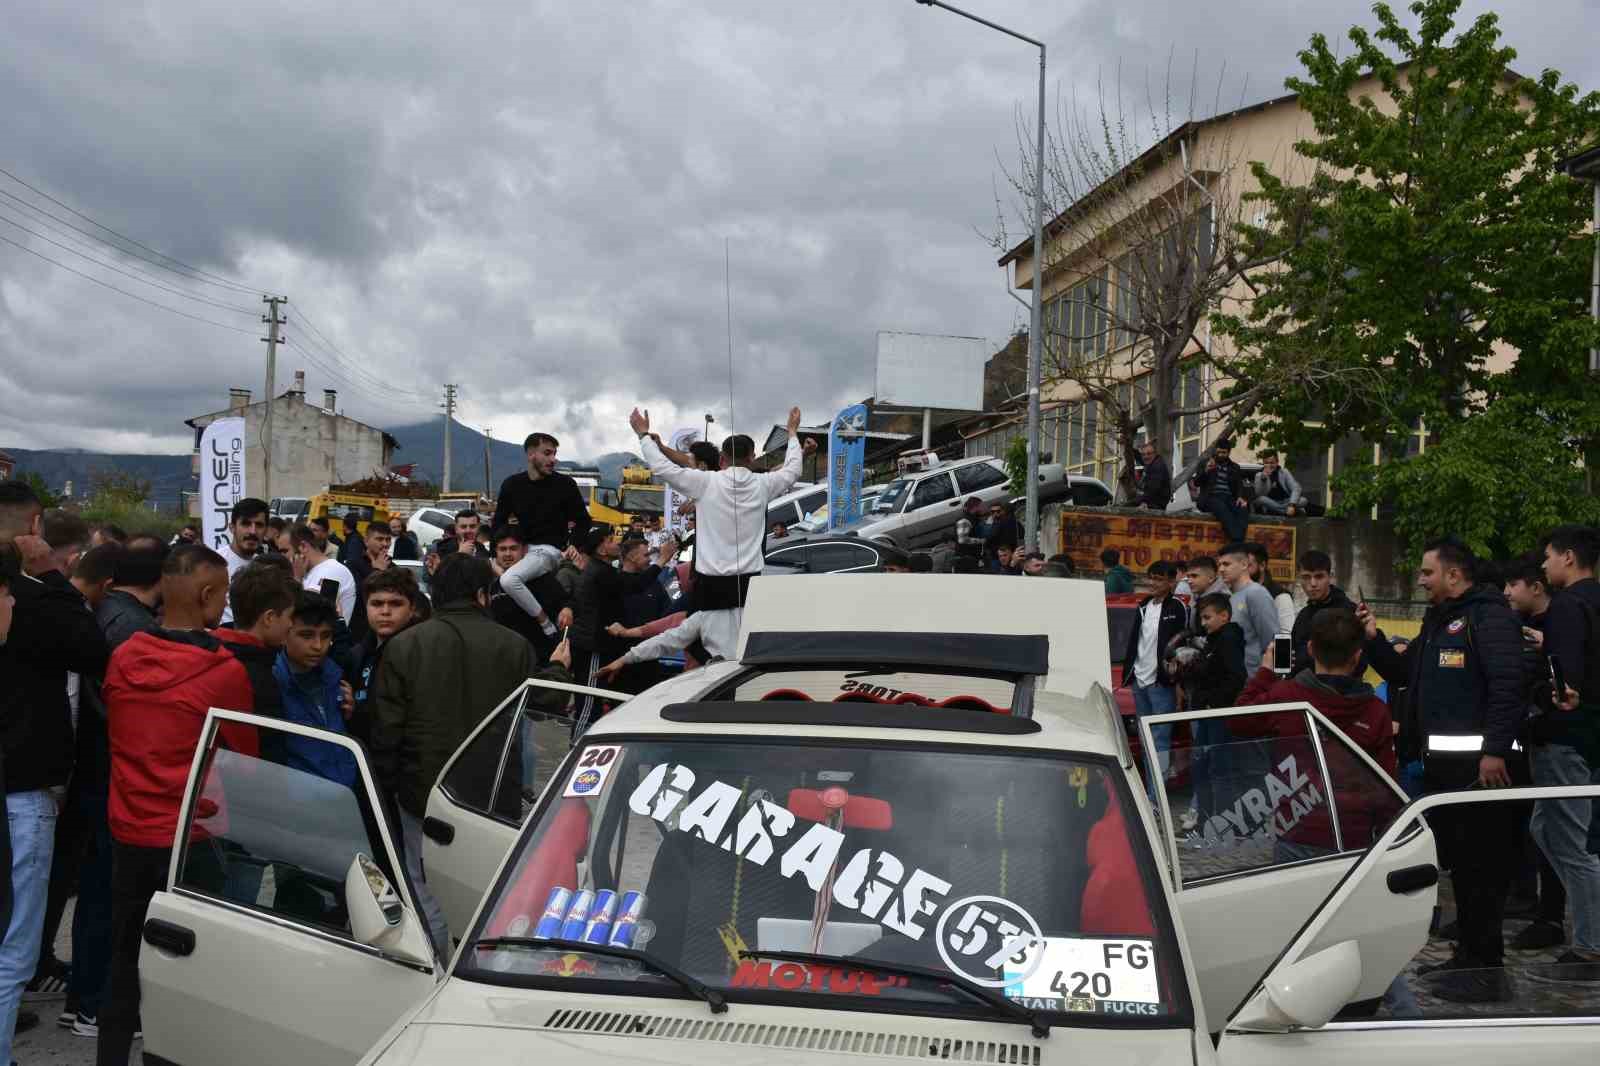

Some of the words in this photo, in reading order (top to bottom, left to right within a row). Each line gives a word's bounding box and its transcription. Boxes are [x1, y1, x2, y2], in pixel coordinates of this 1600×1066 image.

[230, 437, 242, 505] etailing
[579, 748, 616, 768] 20
[628, 763, 952, 941] GARAGE
[1102, 943, 1150, 970] FG
[730, 959, 882, 996] MOTUL
[1050, 970, 1112, 998] 420
[1010, 996, 1058, 1011] TAR
[1103, 1000, 1159, 1016] FUCKS
